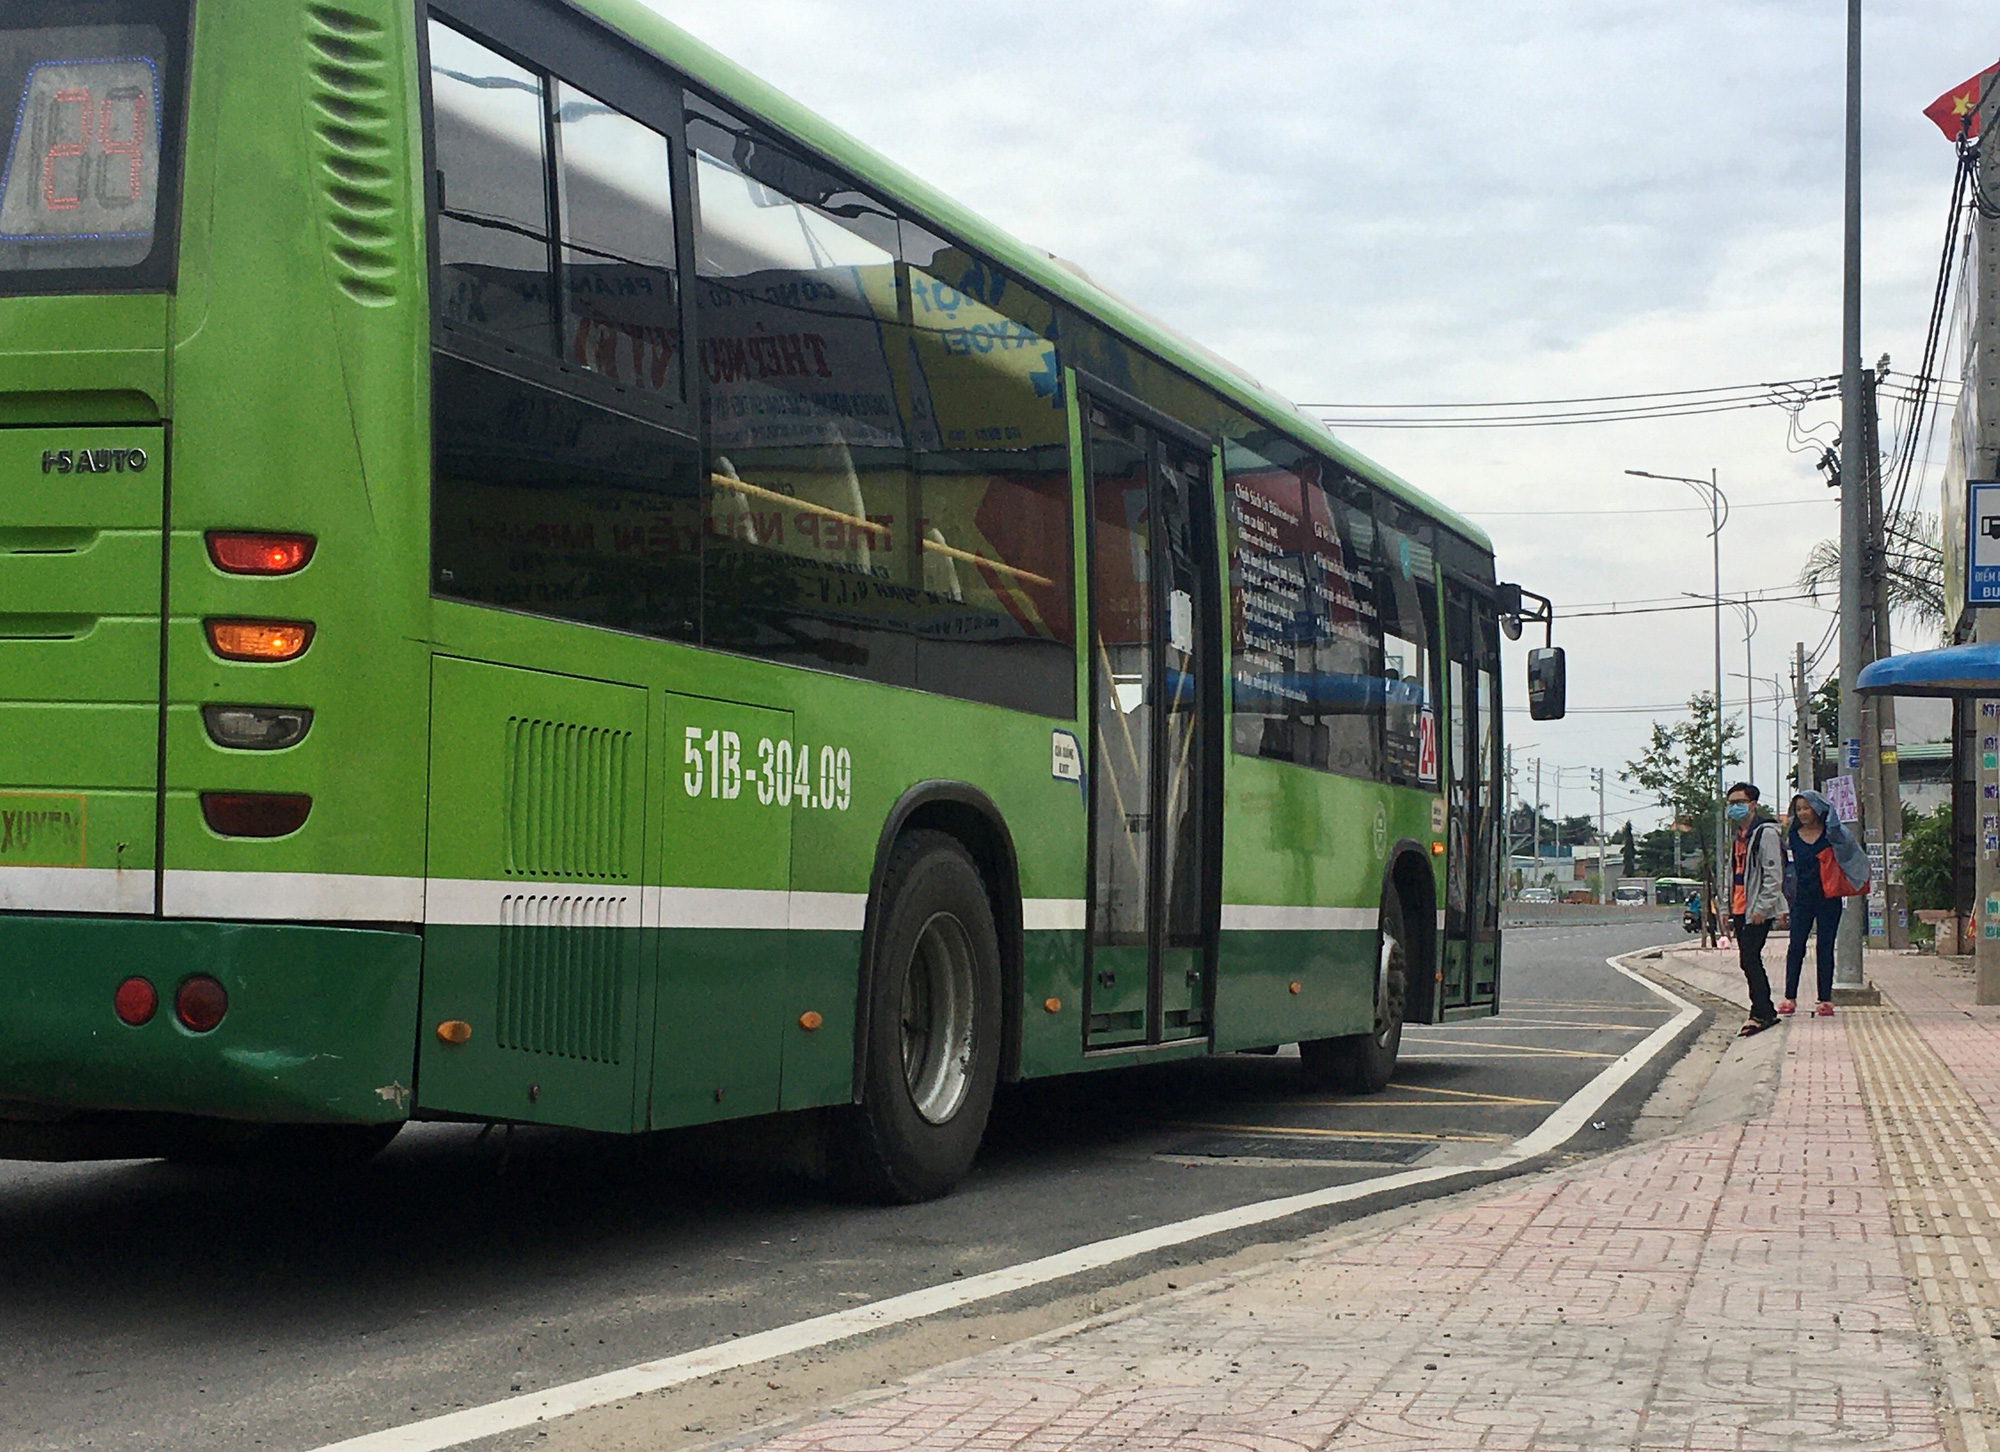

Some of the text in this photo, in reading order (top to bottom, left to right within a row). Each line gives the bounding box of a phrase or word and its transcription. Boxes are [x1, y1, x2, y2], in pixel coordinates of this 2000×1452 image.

[44, 88, 146, 210] 24
[76, 448, 148, 473] AUTO
[684, 726, 851, 811] 51B-304.09
[1421, 716, 1435, 775] 24
